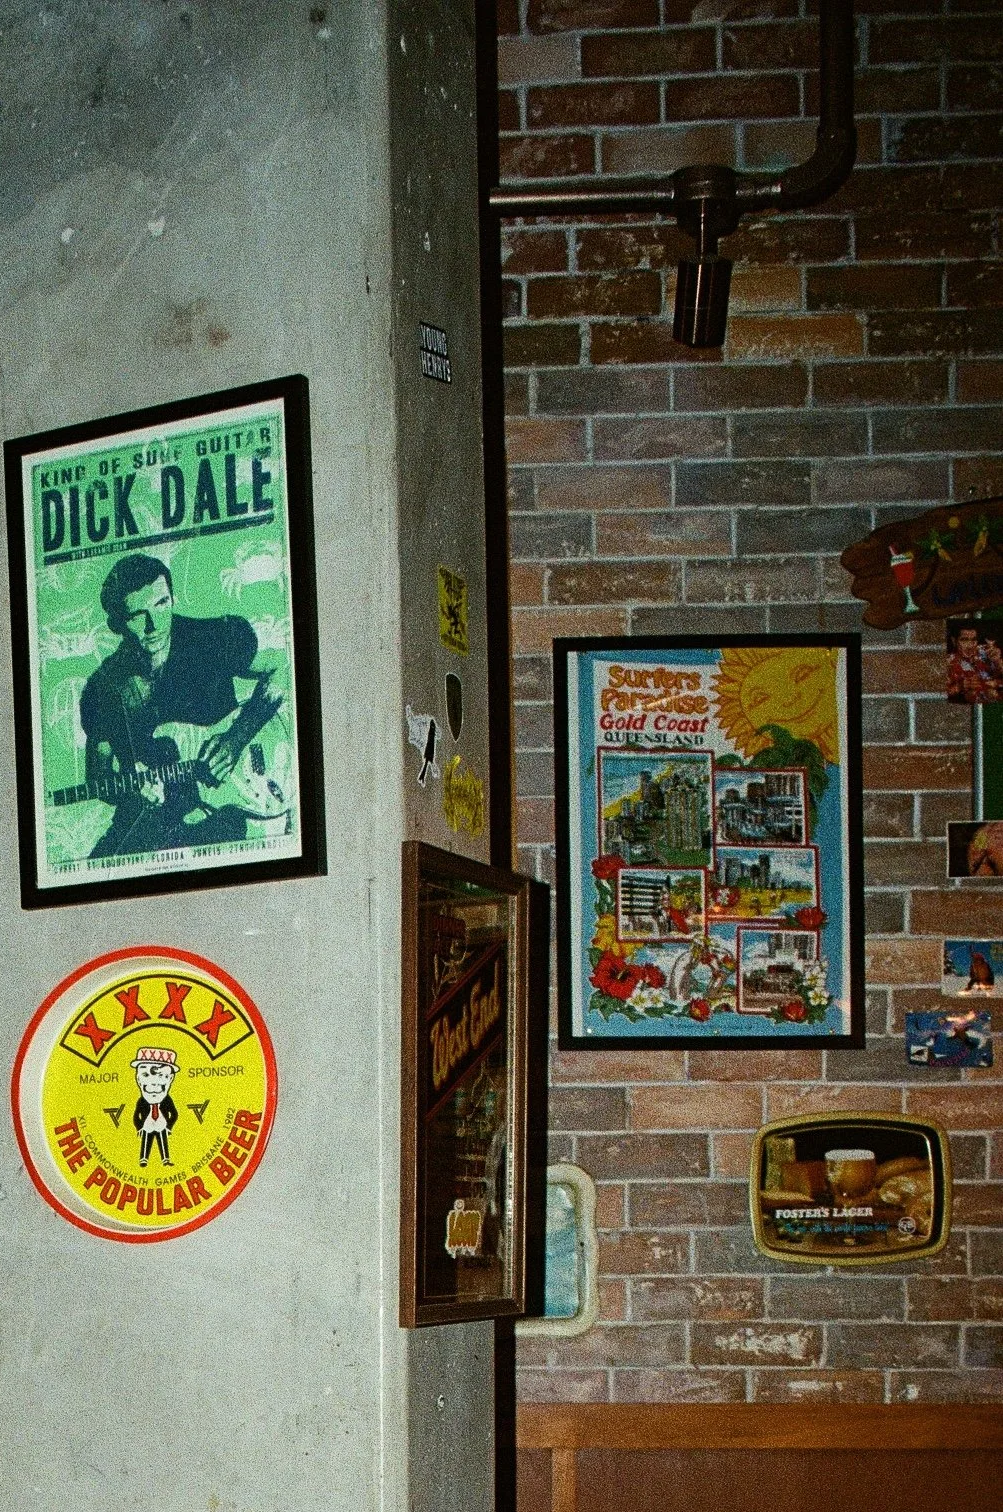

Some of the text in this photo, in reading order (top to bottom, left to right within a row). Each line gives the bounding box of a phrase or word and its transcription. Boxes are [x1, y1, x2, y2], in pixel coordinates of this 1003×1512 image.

[40, 464, 86, 489] KING
[98, 458, 121, 476] OF
[195, 427, 271, 457] GUITAR
[41, 446, 274, 553] DICK DALE
[609, 665, 701, 691] Surfers
[600, 689, 710, 714] Paradise
[599, 713, 710, 734] Gold Coast
[604, 731, 704, 745] QUEENSLAND
[151, 850, 185, 863] FLORIDA
[469, 957, 501, 1050] End
[74, 982, 237, 1056] XXXX
[140, 1049, 174, 1061] XXXX
[79, 1065, 244, 1085] MAJOR SPONSOR
[84, 1134, 149, 1187] COMMONWEALTH
[155, 1172, 188, 1186] GAMES
[191, 1136, 225, 1174] BRISBANE
[222, 1107, 236, 1130] 1982
[54, 1109, 263, 1217] THE POPULAR BEER
[775, 1206, 874, 1219] FOSTER'S LAGER
